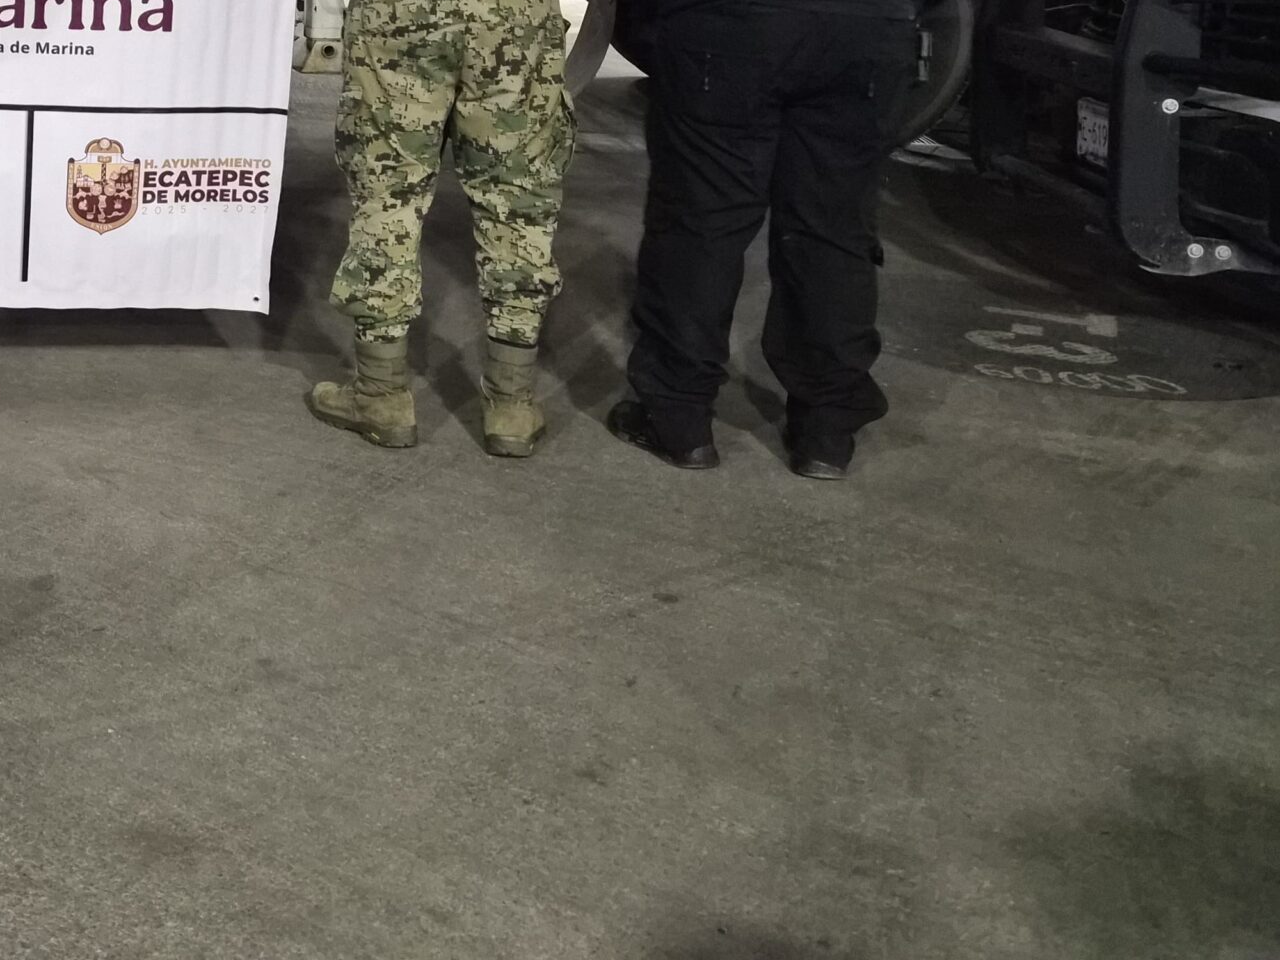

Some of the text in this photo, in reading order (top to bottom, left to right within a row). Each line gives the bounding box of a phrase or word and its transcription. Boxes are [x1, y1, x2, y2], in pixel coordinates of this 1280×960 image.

[10, 41, 30, 54] de
[35, 42, 95, 56] Marina
[144, 158, 272, 169] H. AYUNTAMIENTO
[143, 169, 271, 188] ECATEPEC
[142, 188, 270, 204] DE MORELOS
[141, 205, 187, 215] 2025
[223, 204, 269, 215] 2027
